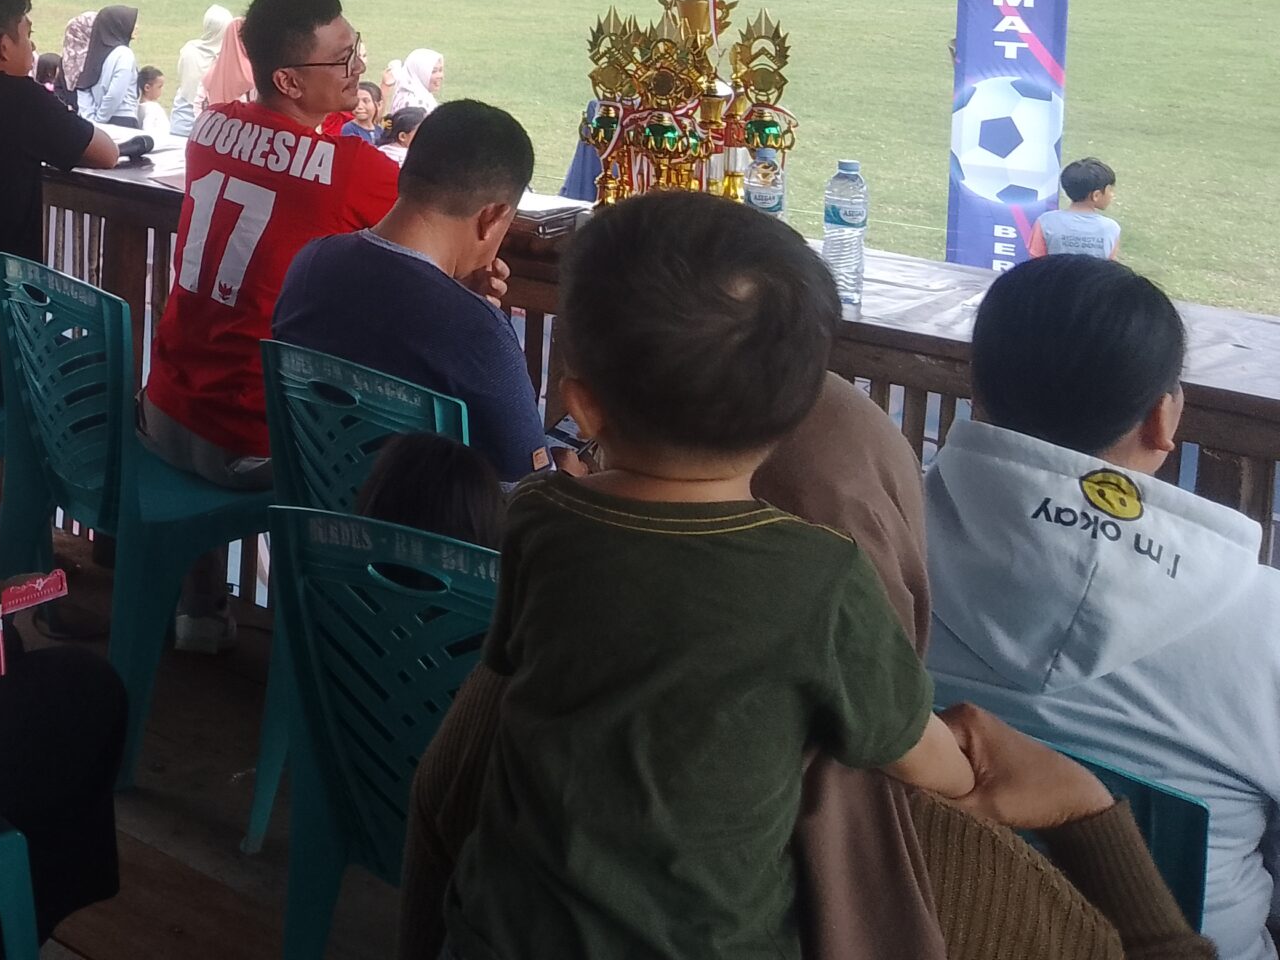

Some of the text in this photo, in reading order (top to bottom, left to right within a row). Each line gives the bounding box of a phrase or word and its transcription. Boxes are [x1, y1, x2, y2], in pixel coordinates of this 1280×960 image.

[179, 169, 276, 307] 17
[1031, 497, 1181, 579] I'm okay
